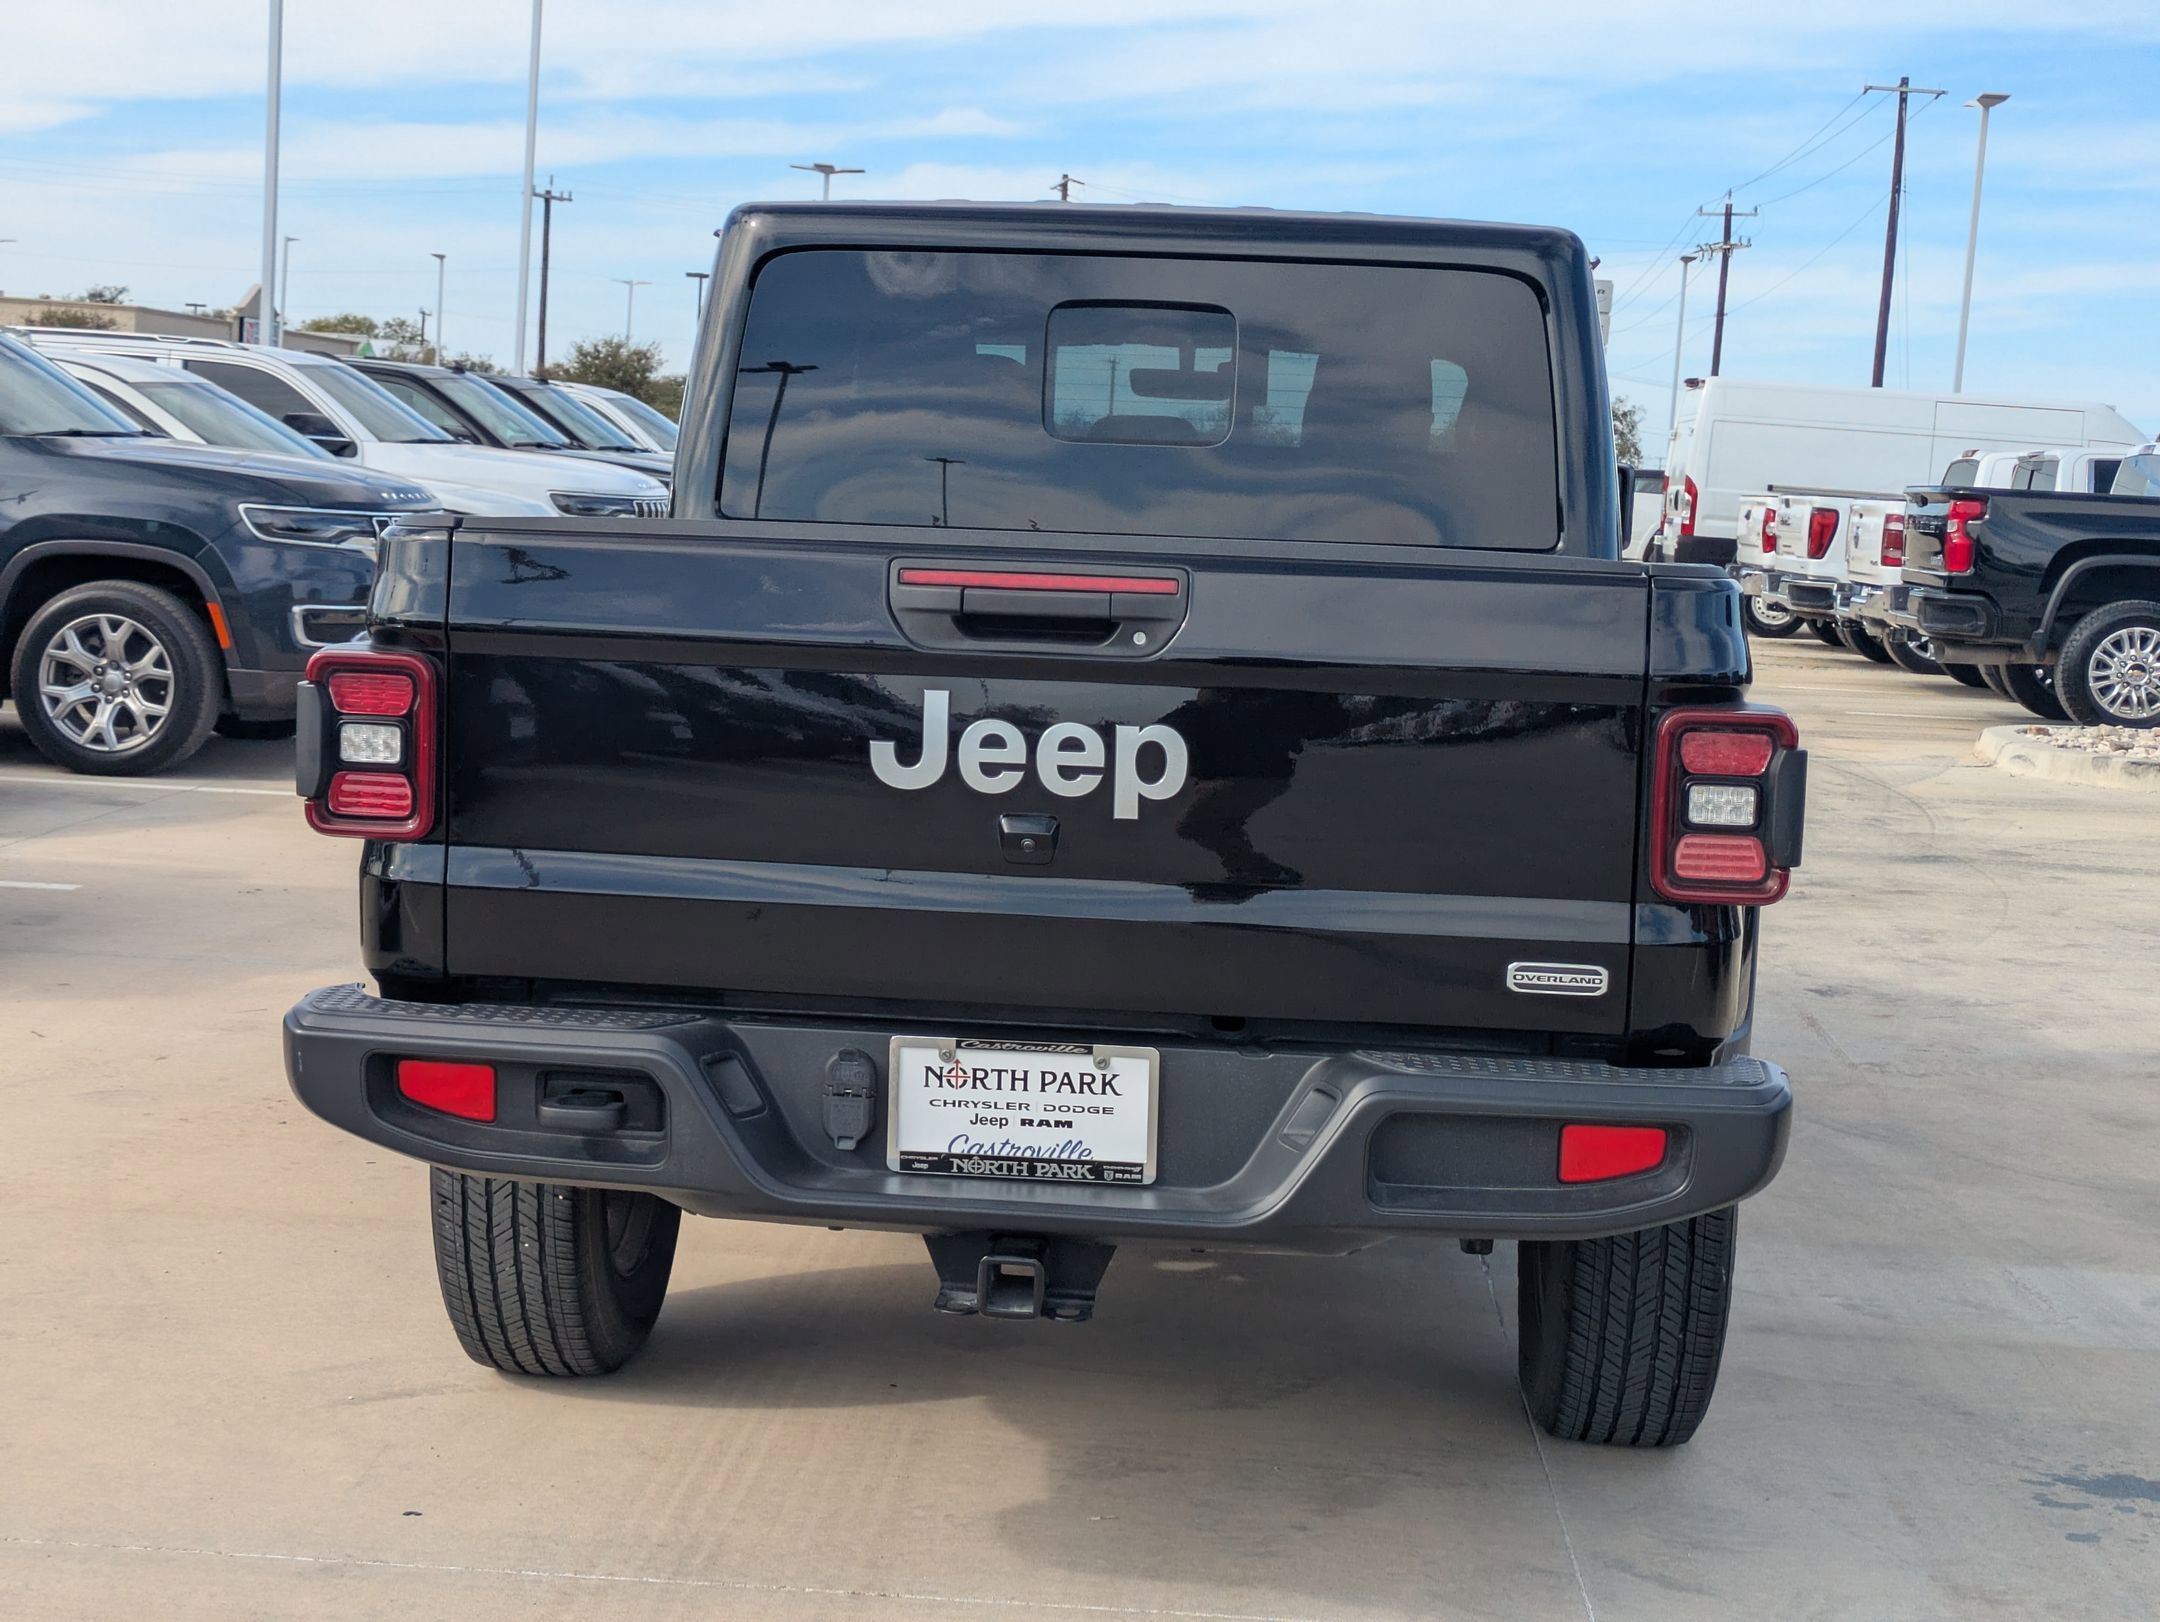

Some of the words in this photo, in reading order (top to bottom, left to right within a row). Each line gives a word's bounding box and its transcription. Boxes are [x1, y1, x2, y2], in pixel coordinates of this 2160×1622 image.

[870, 689, 1188, 819] Jeep
[1513, 973, 1603, 985] OVERLAND
[960, 1040, 1089, 1054] Castroville
[923, 1064, 1029, 1092] NORTH
[1039, 1070, 1123, 1097] PARK
[929, 1099, 1031, 1111] CHRYSLER
[1043, 1103, 1114, 1115] DODGE
[970, 1113, 1009, 1129] Jeep
[1020, 1118, 1073, 1129] RAM
[948, 1133, 1094, 1160] Castroville
[949, 1156, 1029, 1177] NORTH
[1033, 1161, 1096, 1180] PARK
